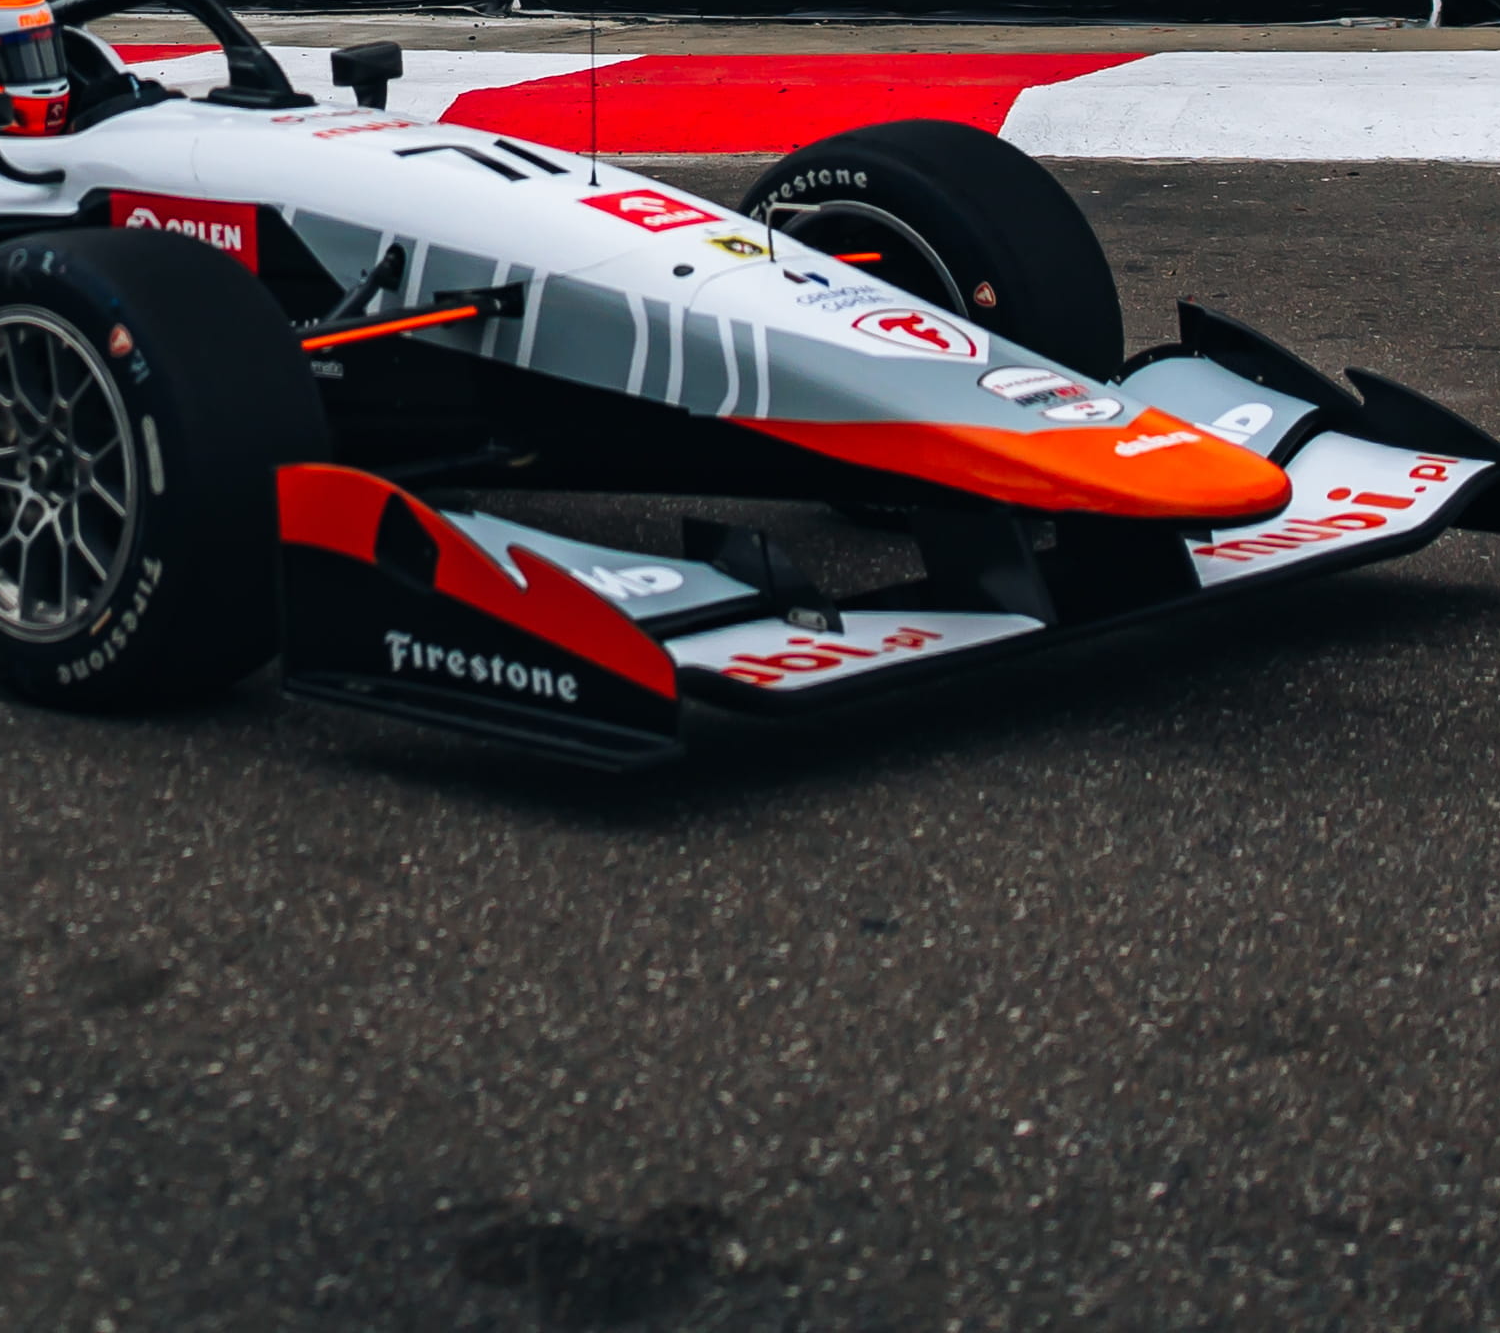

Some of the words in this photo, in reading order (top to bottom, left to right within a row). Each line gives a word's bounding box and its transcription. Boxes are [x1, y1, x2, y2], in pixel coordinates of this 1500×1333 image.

[393, 139, 571, 182] 71
[643, 209, 705, 227] ORLEN
[750, 167, 868, 221] Firestone
[1193, 455, 1460, 562] mubi.pl
[56, 555, 162, 685] Firestone
[385, 630, 579, 704] Firestone
